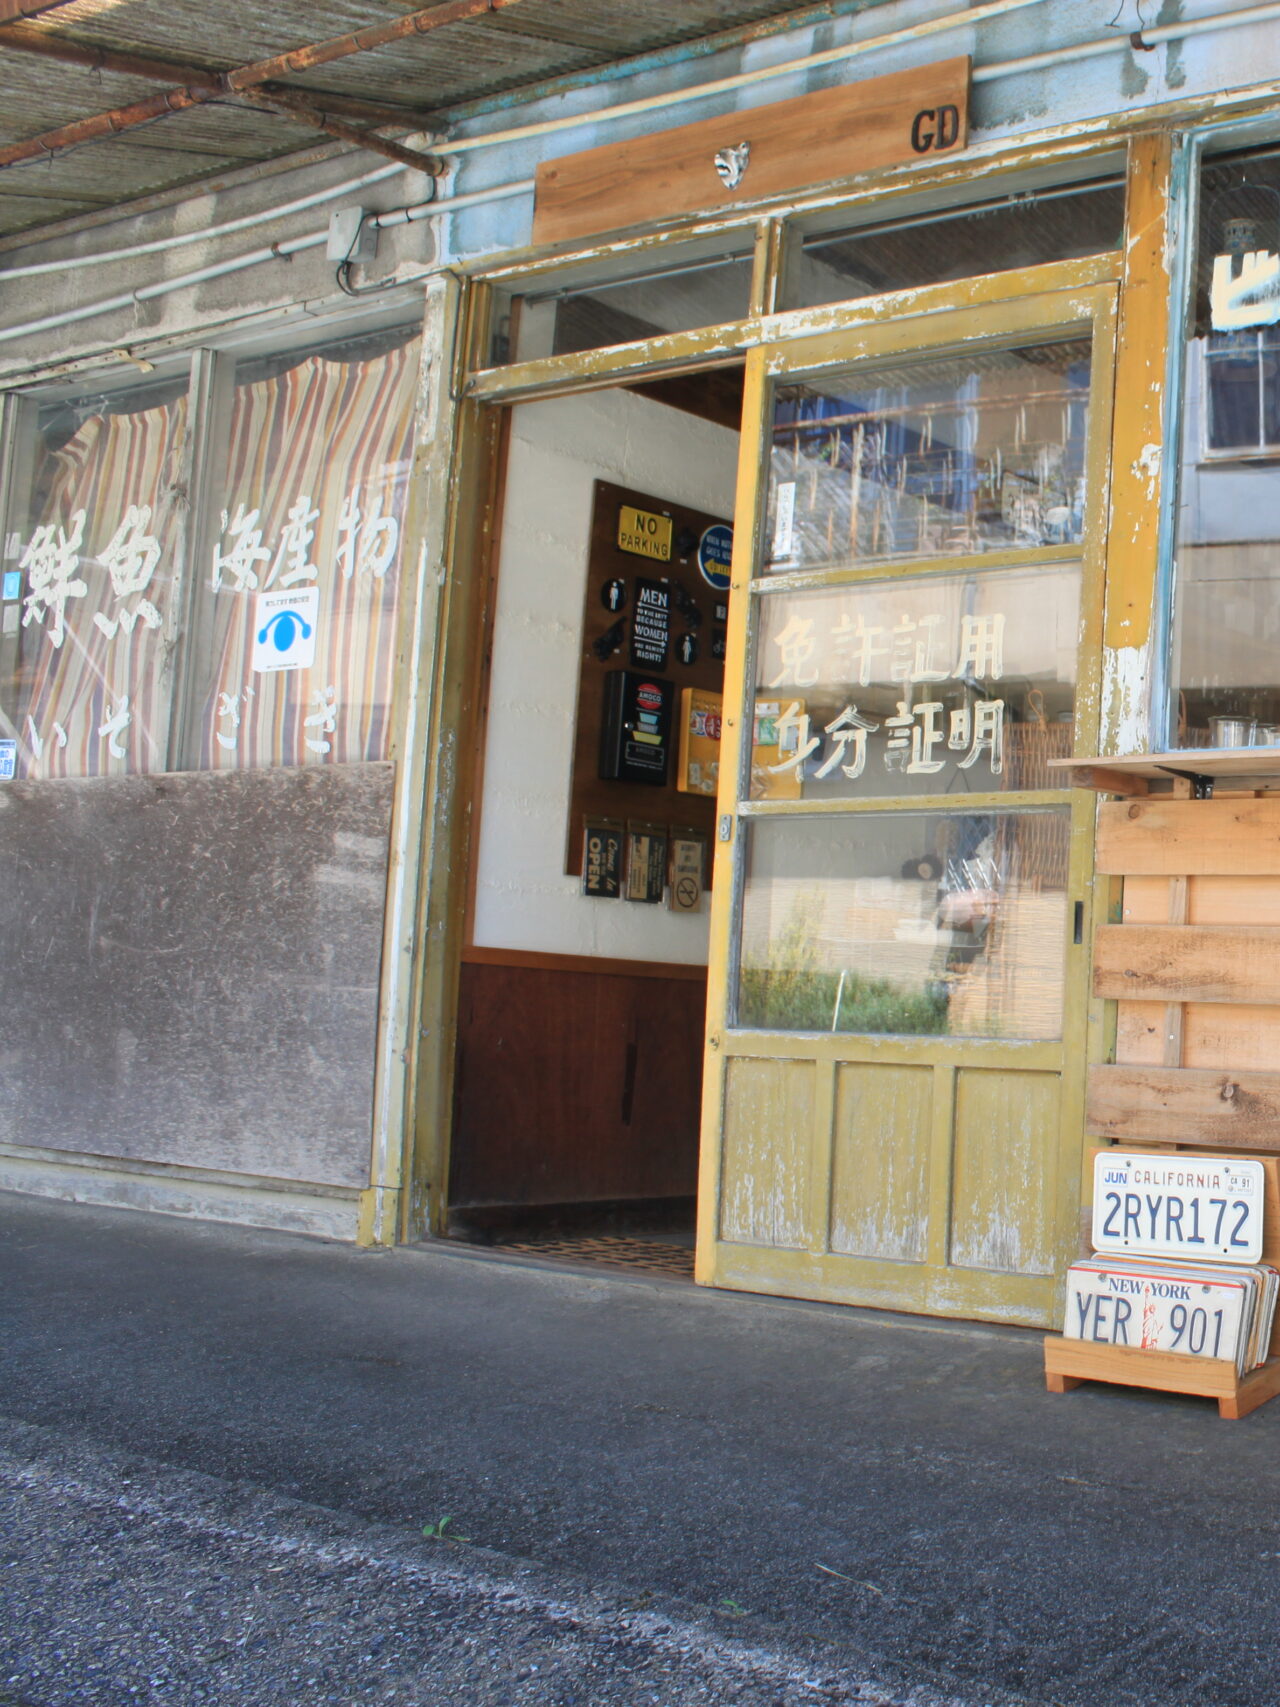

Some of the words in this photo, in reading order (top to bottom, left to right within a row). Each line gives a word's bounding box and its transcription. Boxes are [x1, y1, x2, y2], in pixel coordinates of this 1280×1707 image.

[911, 104, 959, 153] GD
[634, 514, 658, 535] NO
[620, 532, 668, 557] PARKING
[20, 504, 162, 648] 鮮魚
[212, 486, 400, 594] 海産物
[640, 587, 667, 607] MEN
[634, 624, 668, 641] WOMEN
[636, 614, 667, 629] BECAUSE
[769, 613, 1005, 688] 免許証用
[639, 691, 662, 702] AMOCO
[588, 836, 601, 889] OPEN
[1104, 1171, 1128, 1184] JUN
[1134, 1170, 1221, 1189] CALIFORNIA
[1102, 1192, 1251, 1247] 2RYR172
[1108, 1277, 1146, 1294] NEW
[1150, 1282, 1192, 1300] YORK
[1076, 1291, 1132, 1345] YER
[1170, 1303, 1224, 1358] 901
